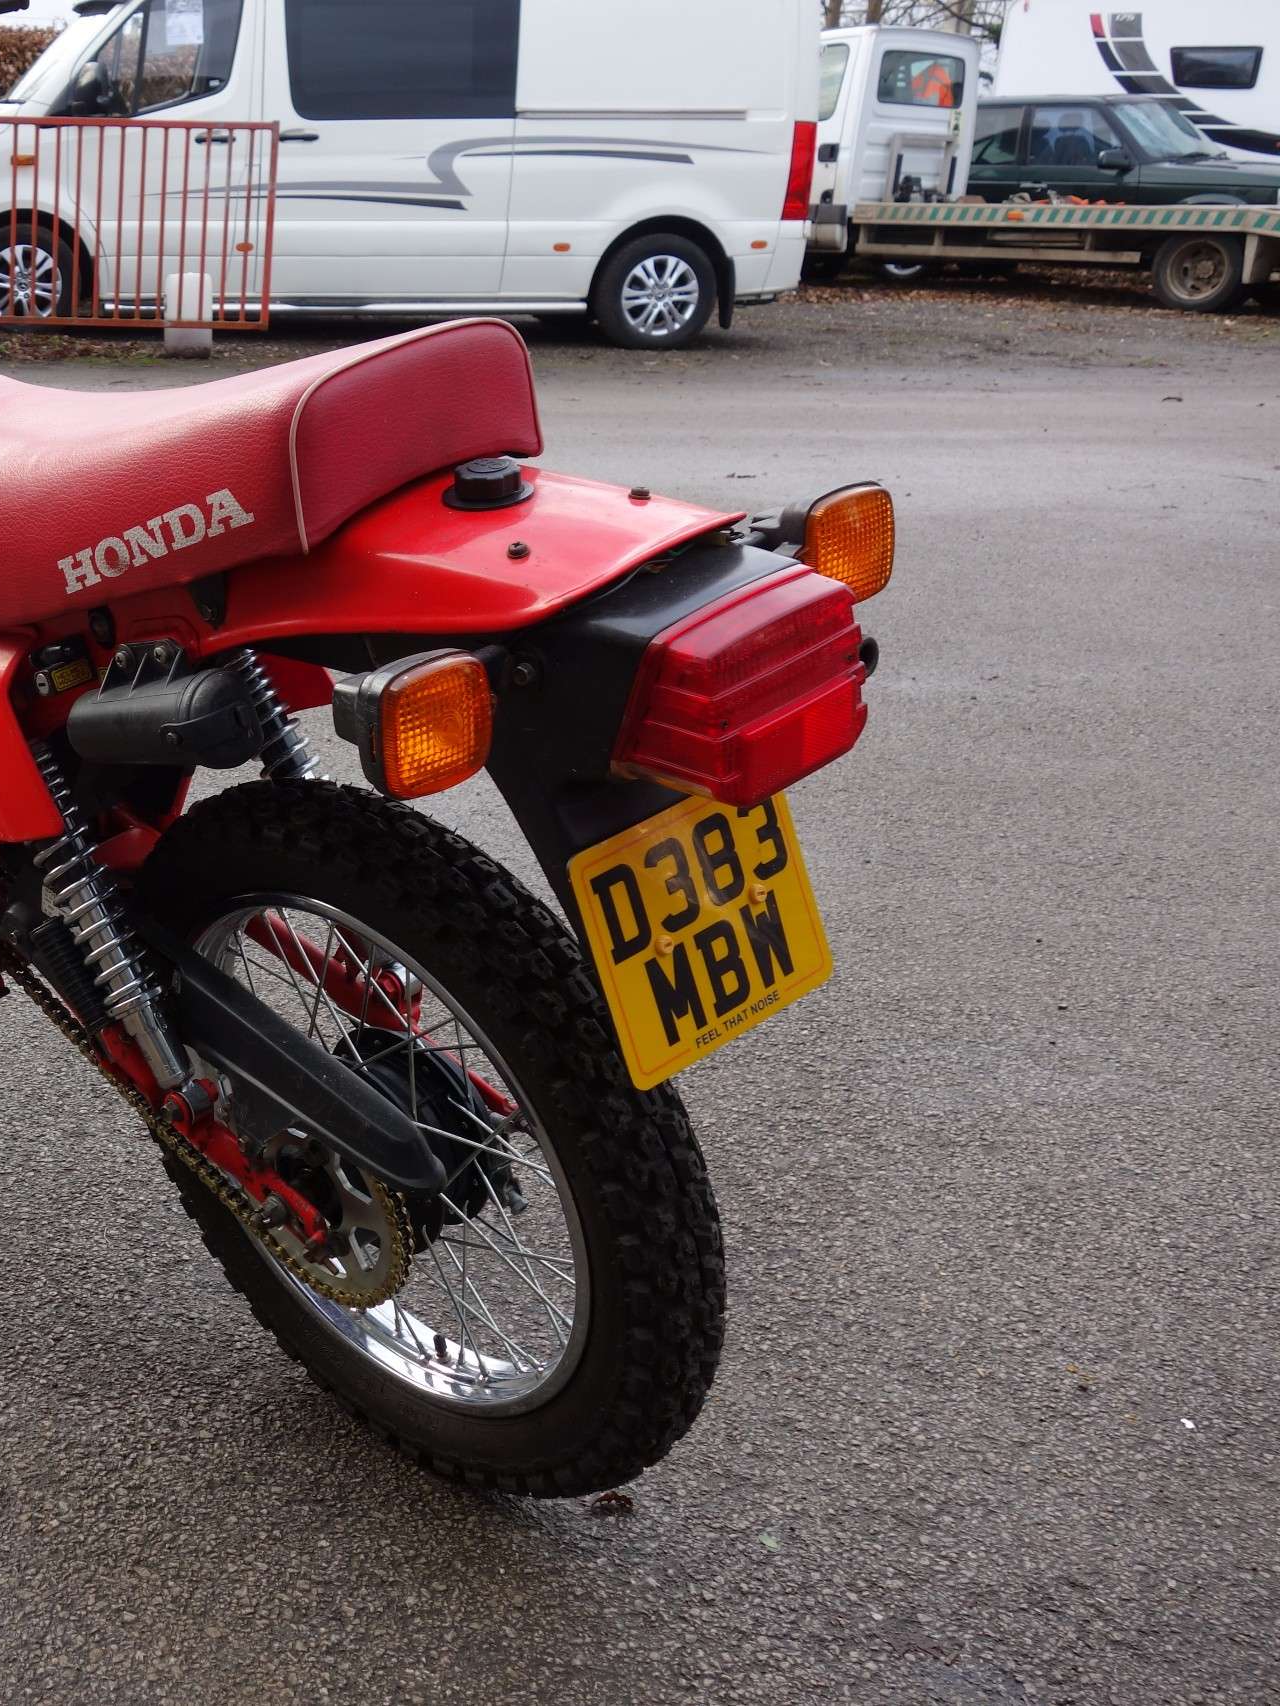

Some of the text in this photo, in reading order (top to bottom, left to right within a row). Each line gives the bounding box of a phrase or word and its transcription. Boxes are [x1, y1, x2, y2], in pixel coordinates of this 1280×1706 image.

[57, 488, 255, 594] HONDA
[590, 798, 788, 966] D383
[644, 889, 794, 1047] MBW
[695, 989, 781, 1049] FEEL THAT NOISE
